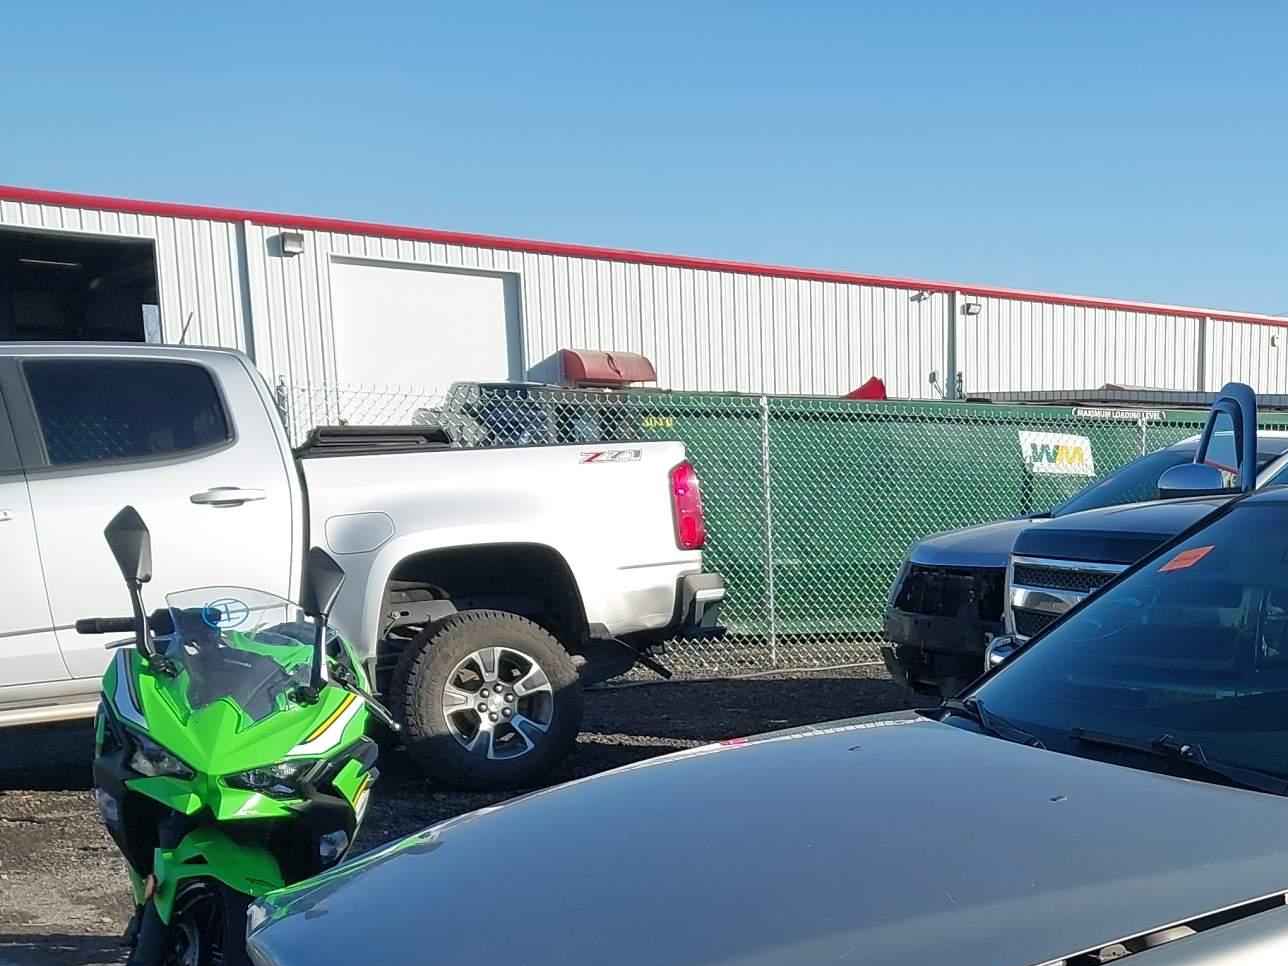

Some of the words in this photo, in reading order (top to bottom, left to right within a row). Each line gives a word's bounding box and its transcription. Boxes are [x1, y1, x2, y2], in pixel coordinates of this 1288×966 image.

[1077, 409, 1111, 418] MAXIMUM
[1112, 410, 1141, 419] LOADING
[1142, 411, 1162, 420] LEVEL
[579, 449, 642, 464] Z71
[1030, 442, 1085, 465] WM
